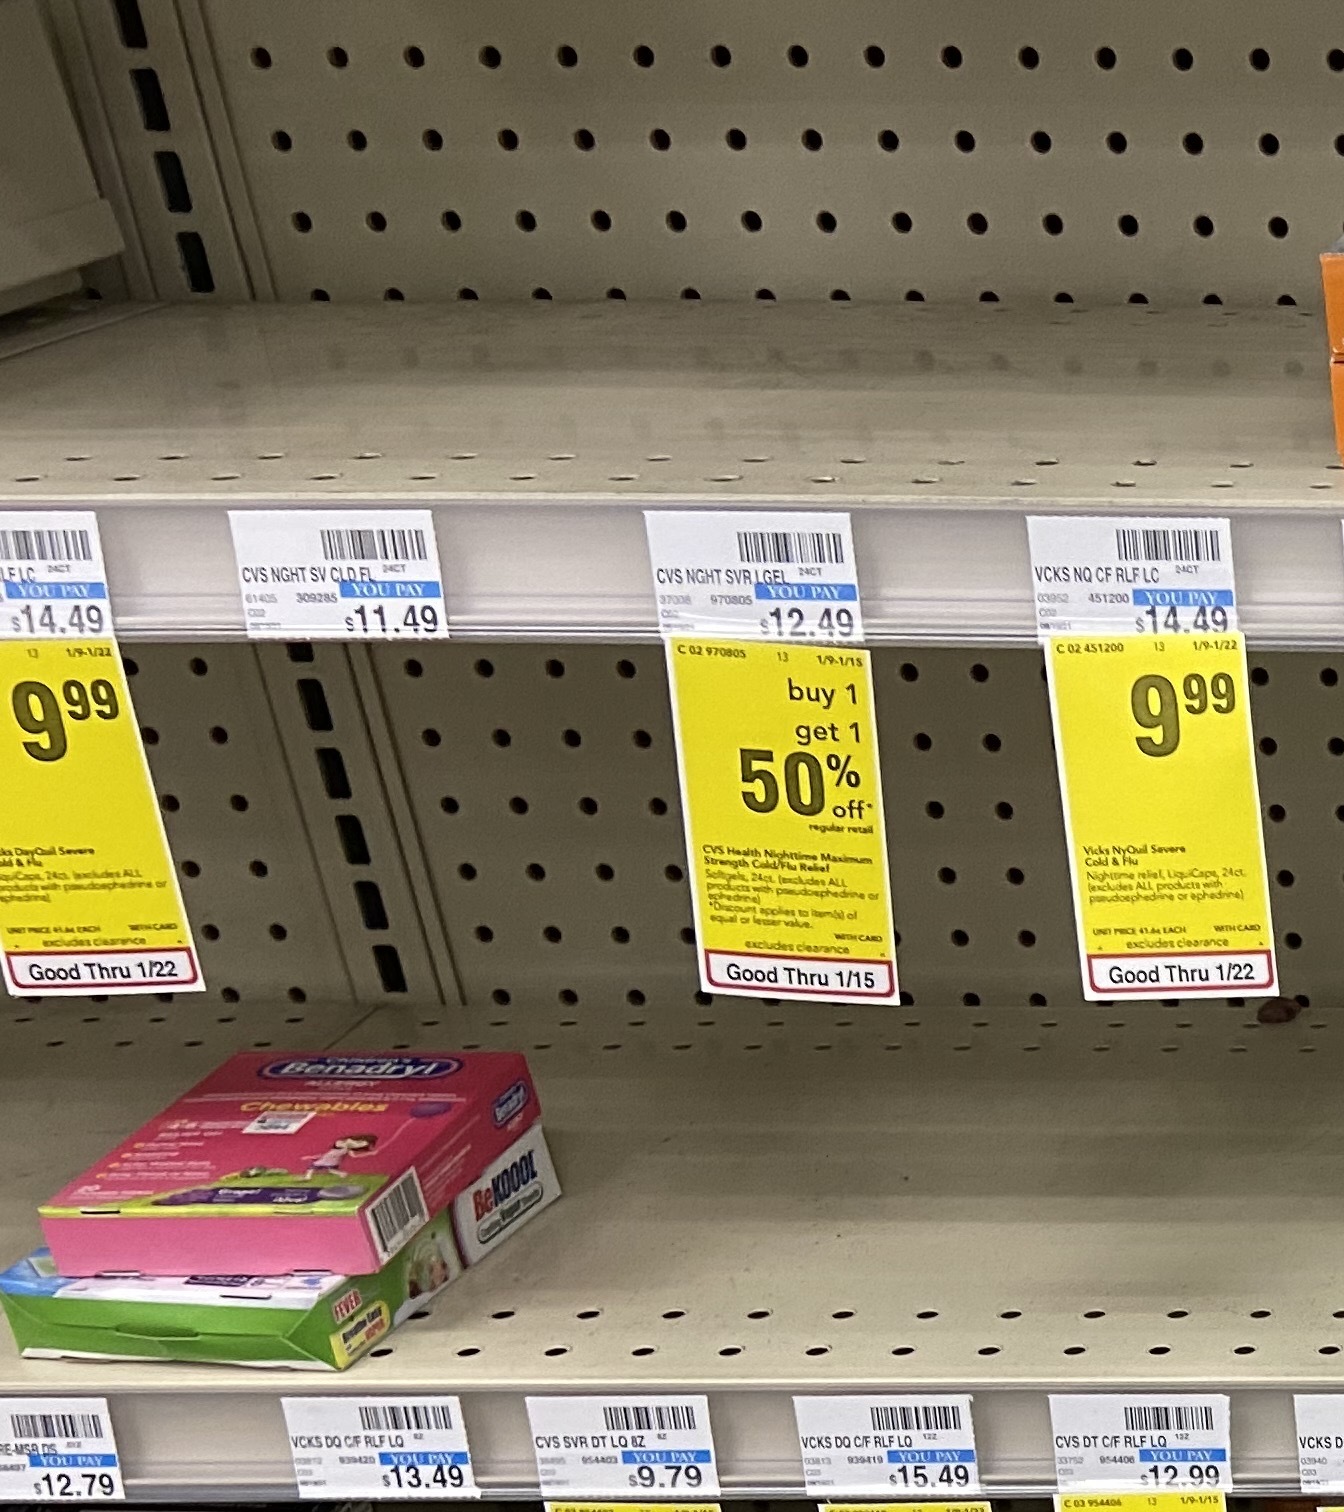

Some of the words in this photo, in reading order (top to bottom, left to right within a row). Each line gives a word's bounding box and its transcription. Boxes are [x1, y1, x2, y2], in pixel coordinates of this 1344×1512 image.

[242, 567, 268, 583] CVS
[271, 567, 306, 582] NGHT
[310, 567, 325, 582] SV
[330, 567, 360, 586] CLD
[657, 568, 683, 584] CVS
[686, 569, 718, 584] NGHT
[726, 569, 752, 584] SVR
[754, 570, 793, 589] LGEL
[297, 593, 337, 603] 309285
[352, 583, 390, 596] YOU
[395, 584, 425, 596] PAY
[345, 605, 438, 633] $11.49
[760, 607, 853, 641] $12.49
[1133, 602, 1233, 634] $14.49
[788, 678, 835, 709] buy
[846, 684, 857, 704] 1
[796, 723, 839, 746] get
[850, 722, 860, 743] 1
[740, 748, 865, 819] 50%
[1083, 846, 1109, 855] Vicks
[1151, 845, 1185, 853] Severe
[1085, 857, 1109, 867] Cold
[1112, 857, 1119, 866] &
[1122, 853, 1138, 866] Flu
[726, 963, 778, 986] Good
[783, 967, 829, 986] Thru
[835, 971, 874, 988] 1/15
[1109, 966, 1159, 984] Good
[1164, 965, 1209, 982] Thru
[1216, 963, 1254, 980] 1/22
[280, 1059, 441, 1078] Benadryl
[239, 1101, 389, 1114] Chewables
[1299, 1437, 1331, 1449] VCKS
[34, 1474, 114, 1496] $12.79
[629, 1465, 702, 1487] $9.79
